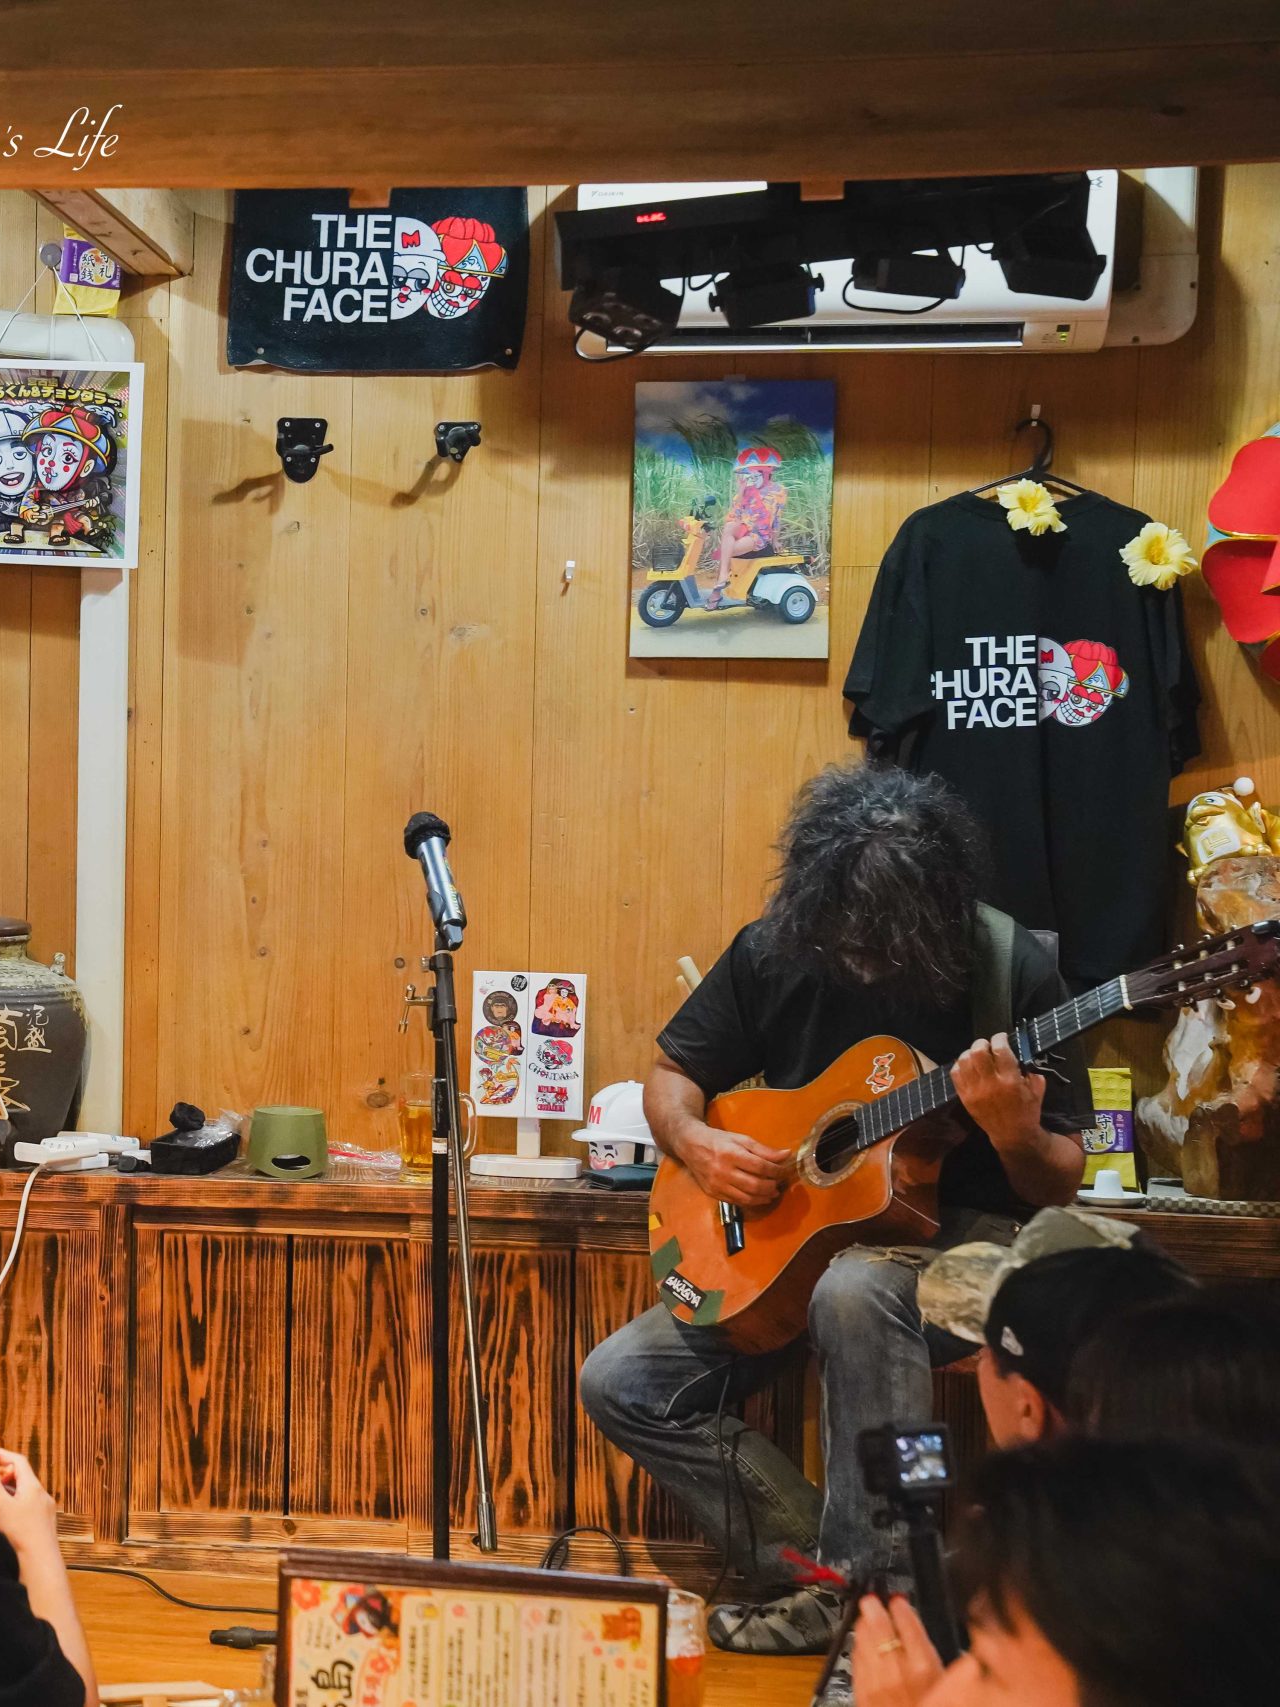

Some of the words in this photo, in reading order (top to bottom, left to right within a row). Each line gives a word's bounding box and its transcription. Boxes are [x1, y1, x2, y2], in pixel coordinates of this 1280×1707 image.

[311, 213, 393, 249] THE
[245, 247, 389, 286] CHURA
[282, 286, 388, 324] FACE
[965, 634, 1036, 667] THE
[930, 666, 1038, 700] HURA
[947, 697, 1037, 730] FACE
[589, 1104, 602, 1125] M
